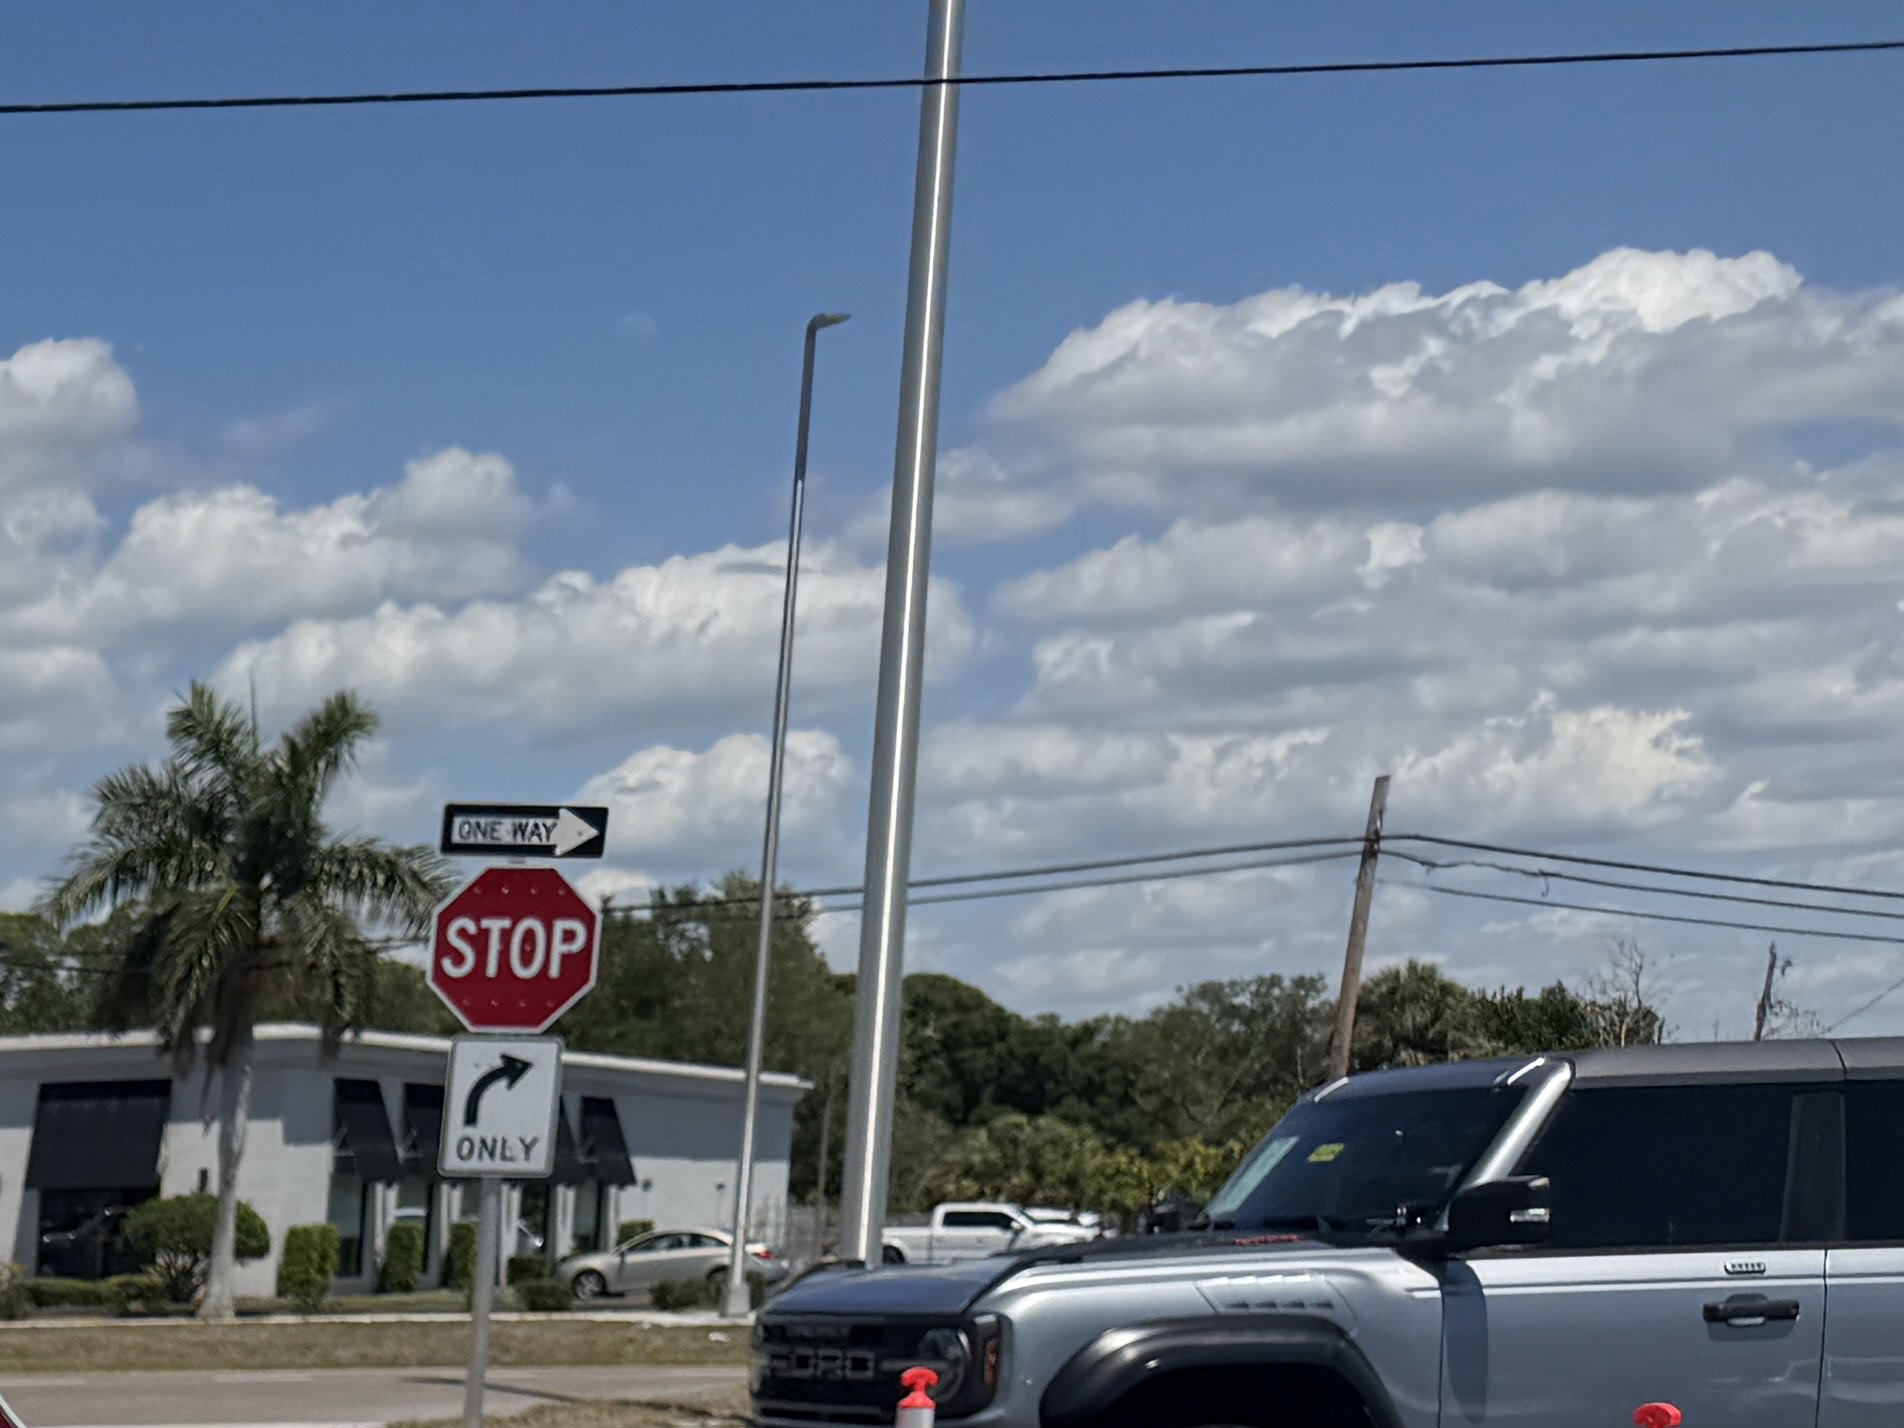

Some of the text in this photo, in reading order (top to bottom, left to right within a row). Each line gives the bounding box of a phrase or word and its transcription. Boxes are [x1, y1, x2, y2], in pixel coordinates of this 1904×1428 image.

[458, 820, 558, 843] ONE WAY
[440, 916, 588, 980] STOP
[456, 1135, 539, 1163] ONLY
